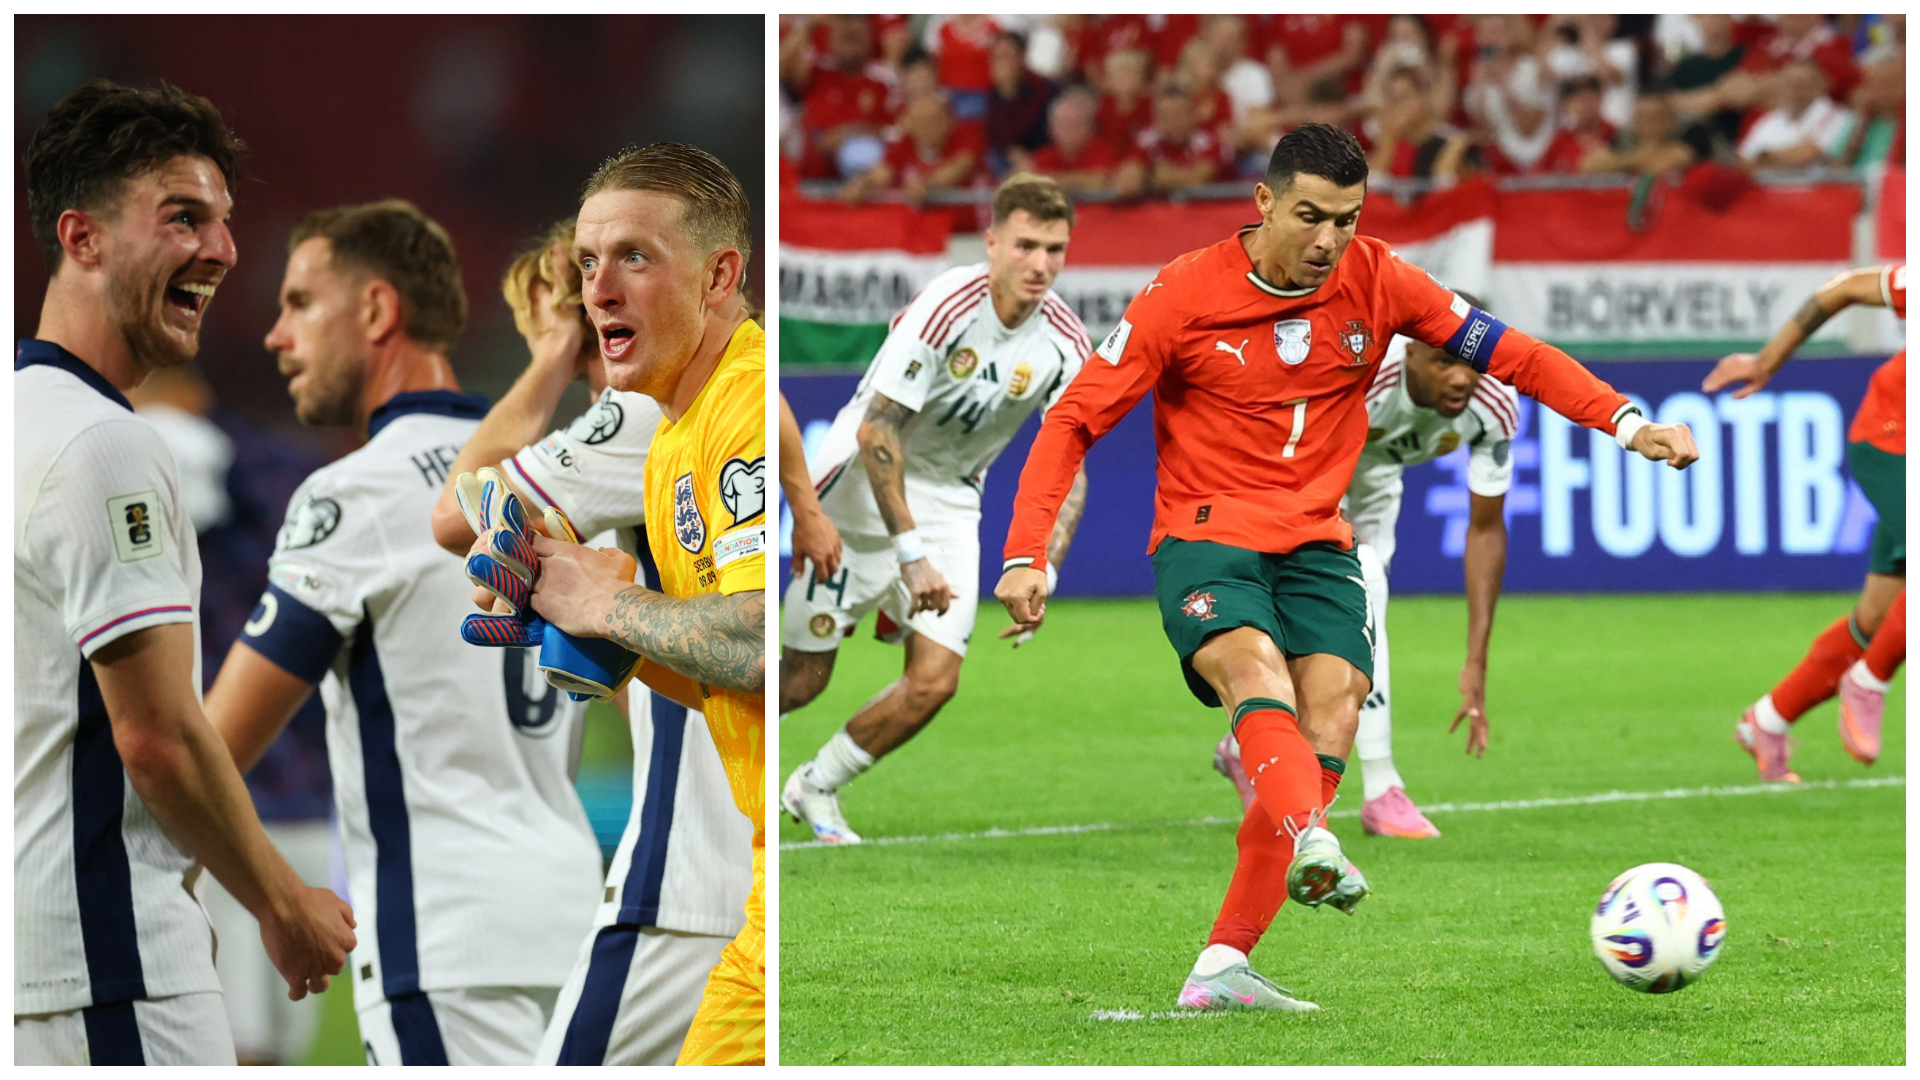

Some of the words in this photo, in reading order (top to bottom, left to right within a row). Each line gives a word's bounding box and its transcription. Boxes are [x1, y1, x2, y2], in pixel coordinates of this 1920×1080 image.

[1461, 319, 1487, 360] RESPECT
[1281, 397, 1308, 458] 7
[410, 443, 460, 487] HE
[1426, 390, 1880, 557] #FOOTB
